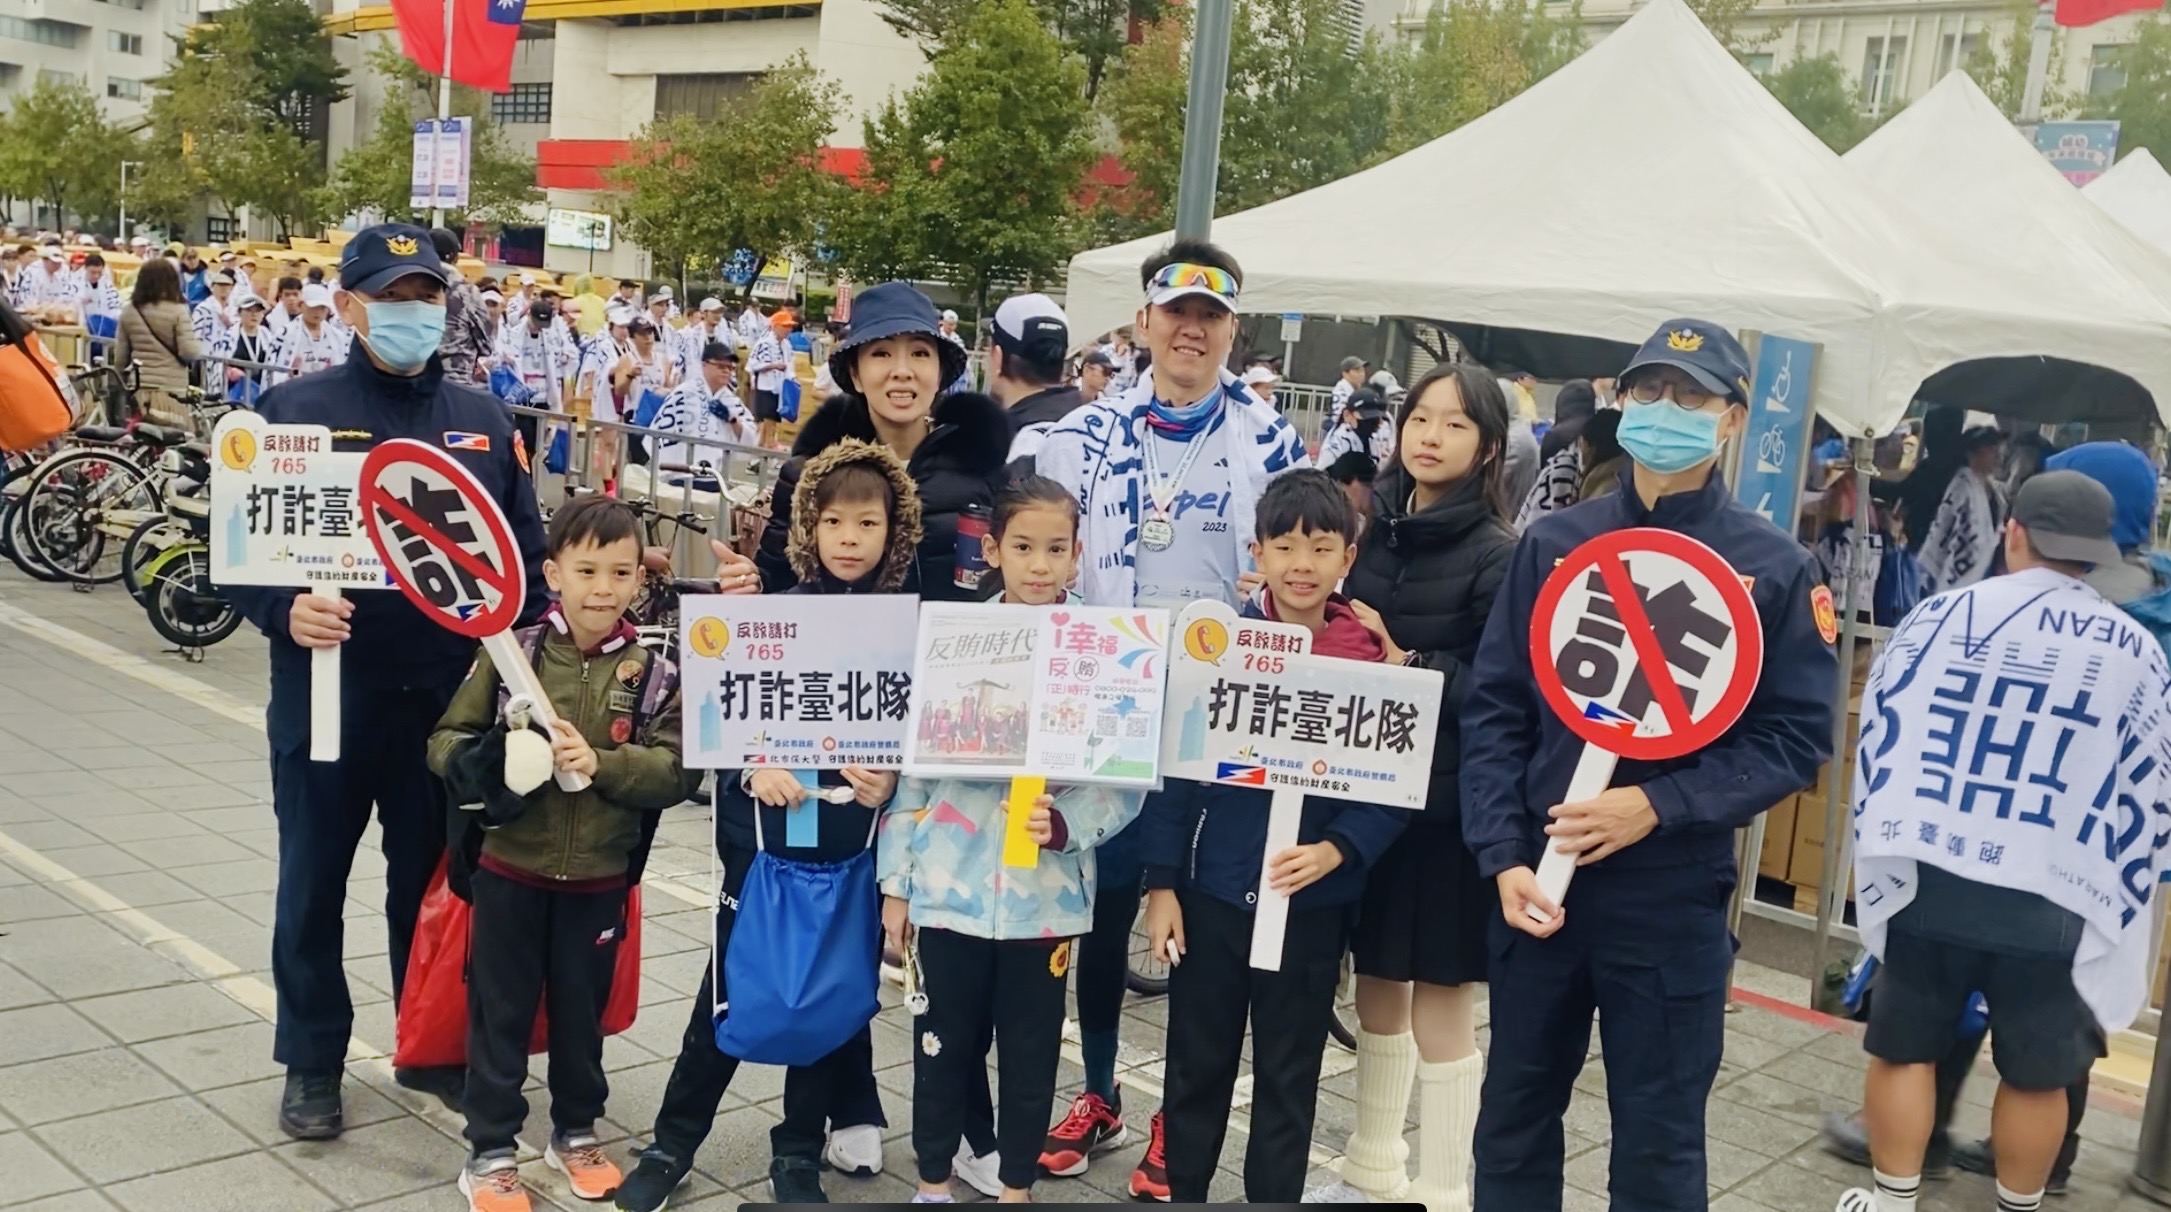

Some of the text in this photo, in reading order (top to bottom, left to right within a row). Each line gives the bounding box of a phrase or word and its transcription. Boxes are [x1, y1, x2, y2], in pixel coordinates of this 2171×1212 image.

[264, 434, 320, 453] 反詐請打
[270, 457, 307, 474] 165
[246, 484, 370, 538] 打詐臺
[1202, 521, 1227, 532] 2023
[737, 622, 798, 639] 反詐請打
[1236, 629, 1304, 654] 反詐請打
[2037, 606, 2143, 658] MEAN
[745, 643, 784, 660] 165
[924, 628, 1038, 660] 反賄時代
[1243, 653, 1285, 674] 165
[719, 670, 912, 721] 打詐臺北隊
[1208, 678, 1419, 754] 打詐臺北隊
